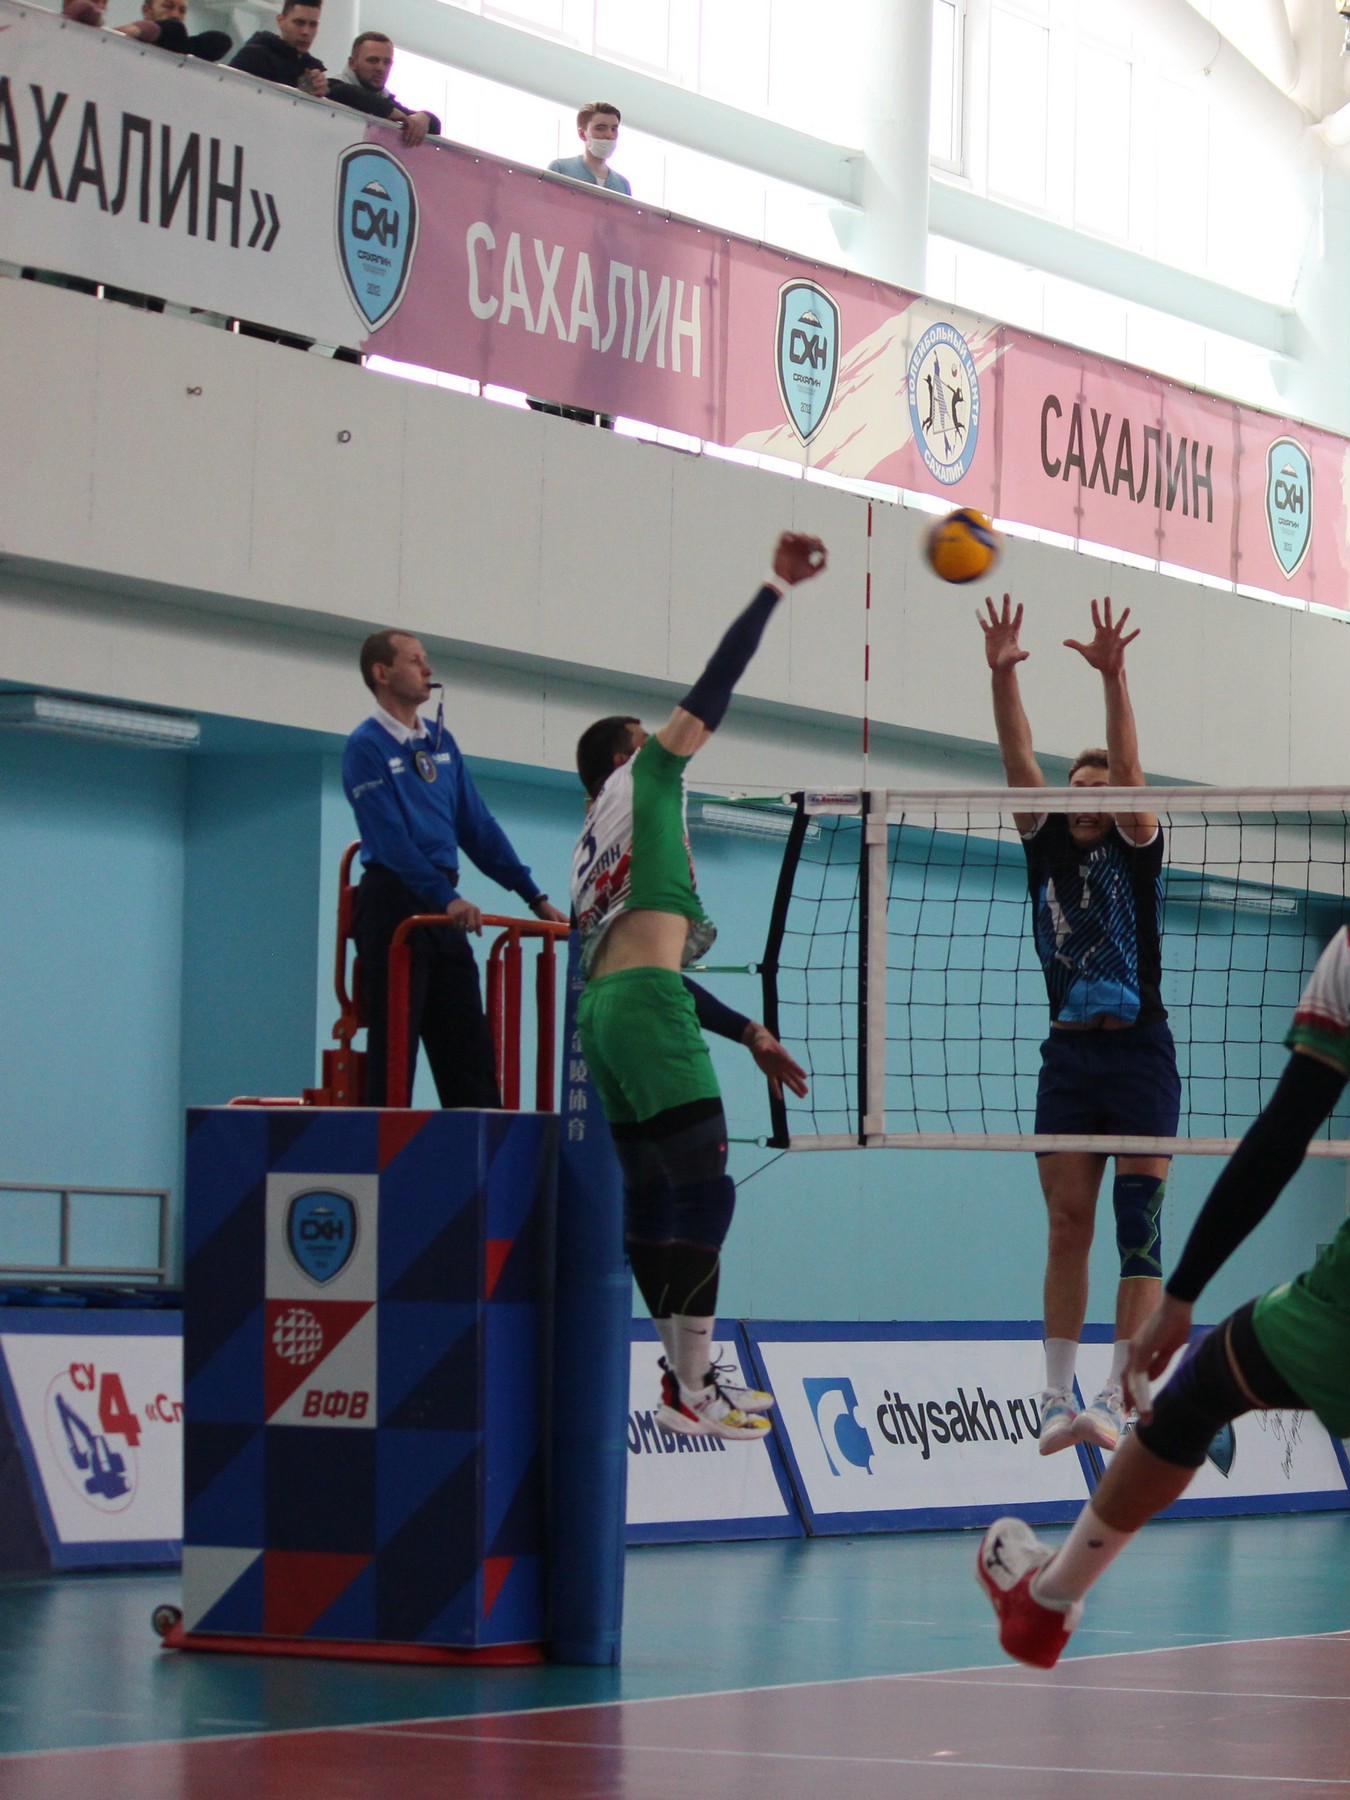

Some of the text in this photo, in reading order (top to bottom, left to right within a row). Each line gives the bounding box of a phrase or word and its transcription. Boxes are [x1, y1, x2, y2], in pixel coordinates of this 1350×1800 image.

[466, 221, 701, 378] САХАЛИН
[909, 326, 979, 427] ВОЛЕЙБОЛЬНЫЙ ЦЕНТР
[923, 448, 965, 483] САХАЛИН
[1041, 394, 1213, 523] САХАЛИН
[99, 1372, 141, 1447] 4
[302, 1389, 369, 1419] ВФВ
[876, 1387, 1042, 1460] citysakh.ru
